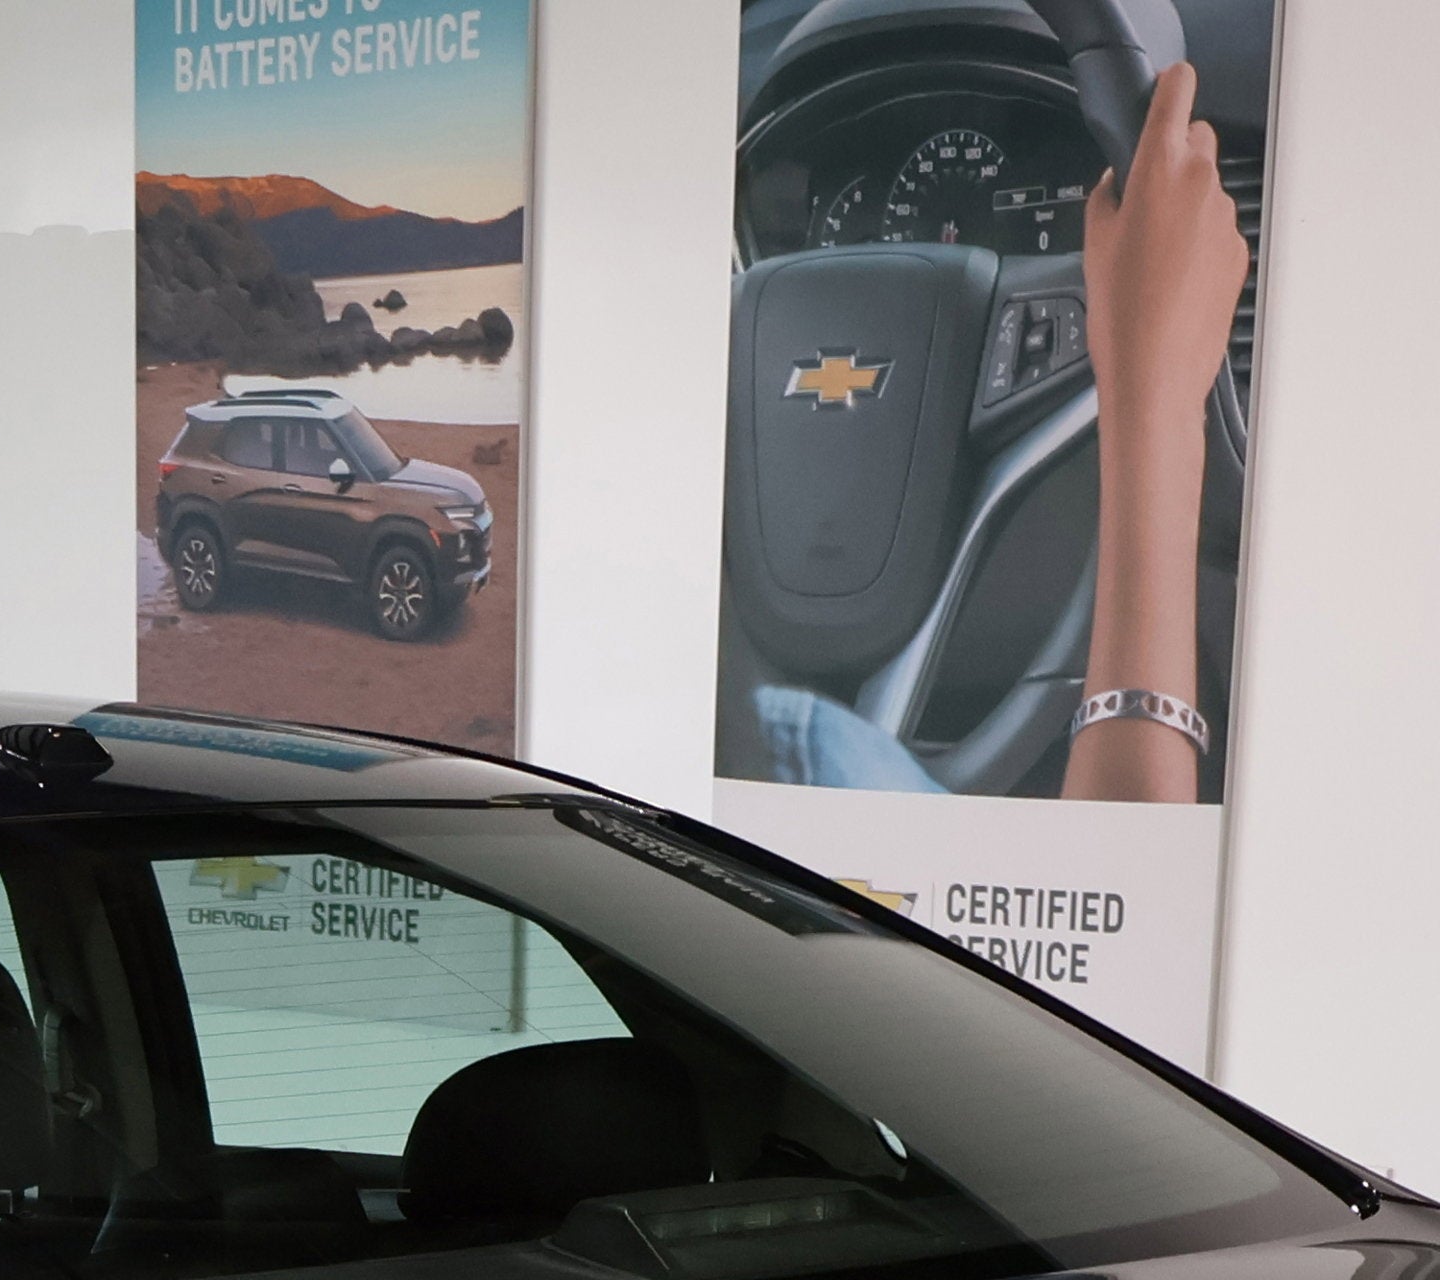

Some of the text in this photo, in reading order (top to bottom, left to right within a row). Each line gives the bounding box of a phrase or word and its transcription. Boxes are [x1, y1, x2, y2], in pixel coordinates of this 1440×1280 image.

[173, 0, 199, 35] IT
[174, 10, 482, 93] BATTERY SERVICE
[311, 858, 445, 901] CERTIFIED
[188, 907, 290, 932] CHEVROLET
[311, 902, 420, 943] SERVICE
[945, 883, 1126, 934] CERTIFIED
